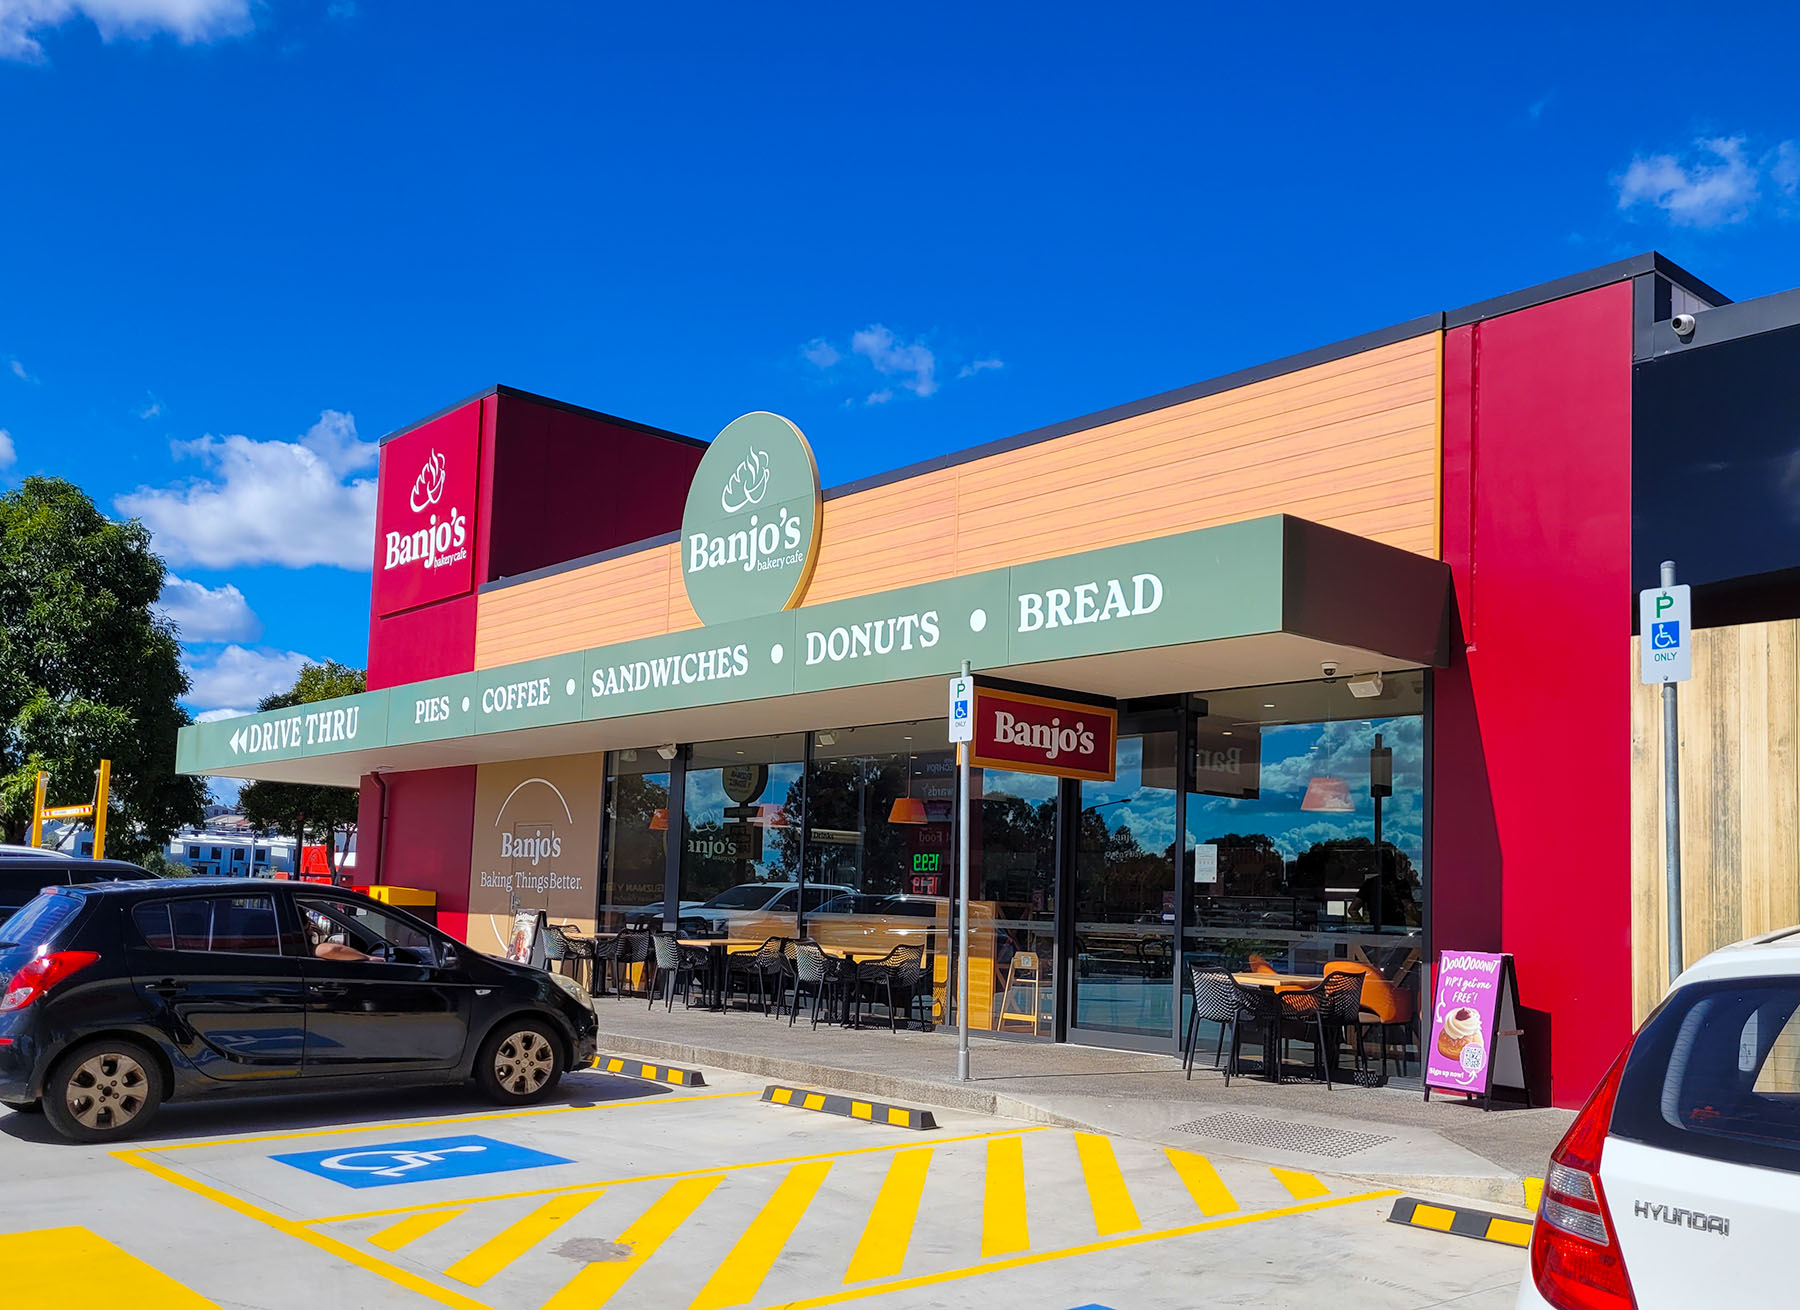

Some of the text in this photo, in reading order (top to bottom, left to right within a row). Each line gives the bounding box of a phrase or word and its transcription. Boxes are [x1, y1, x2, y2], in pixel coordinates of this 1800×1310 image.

[384, 507, 466, 570] Banjo's
[688, 507, 801, 573] Banjo's
[434, 547, 467, 568] bakery cafe
[757, 550, 804, 571] bakery cafe
[1656, 595, 1674, 618] P
[415, 573, 1164, 724] PIES COFFEE SANDWICHES DONUTS BREAD
[1654, 651, 1677, 662] ONLY
[956, 683, 966, 698] P
[249, 706, 360, 753] DRIVE THRU
[993, 710, 1095, 760] Banjo's
[500, 829, 562, 866] Banjo's
[687, 835, 737, 859] anjo's
[480, 871, 513, 893] Baking
[515, 872, 549, 894] Things
[549, 872, 583, 890] Better.
[1461, 977, 1478, 992] get
[1477, 982, 1492, 990] one
[1442, 1070, 1450, 1078] up
[1634, 1199, 1730, 1237] HYUNDAI
